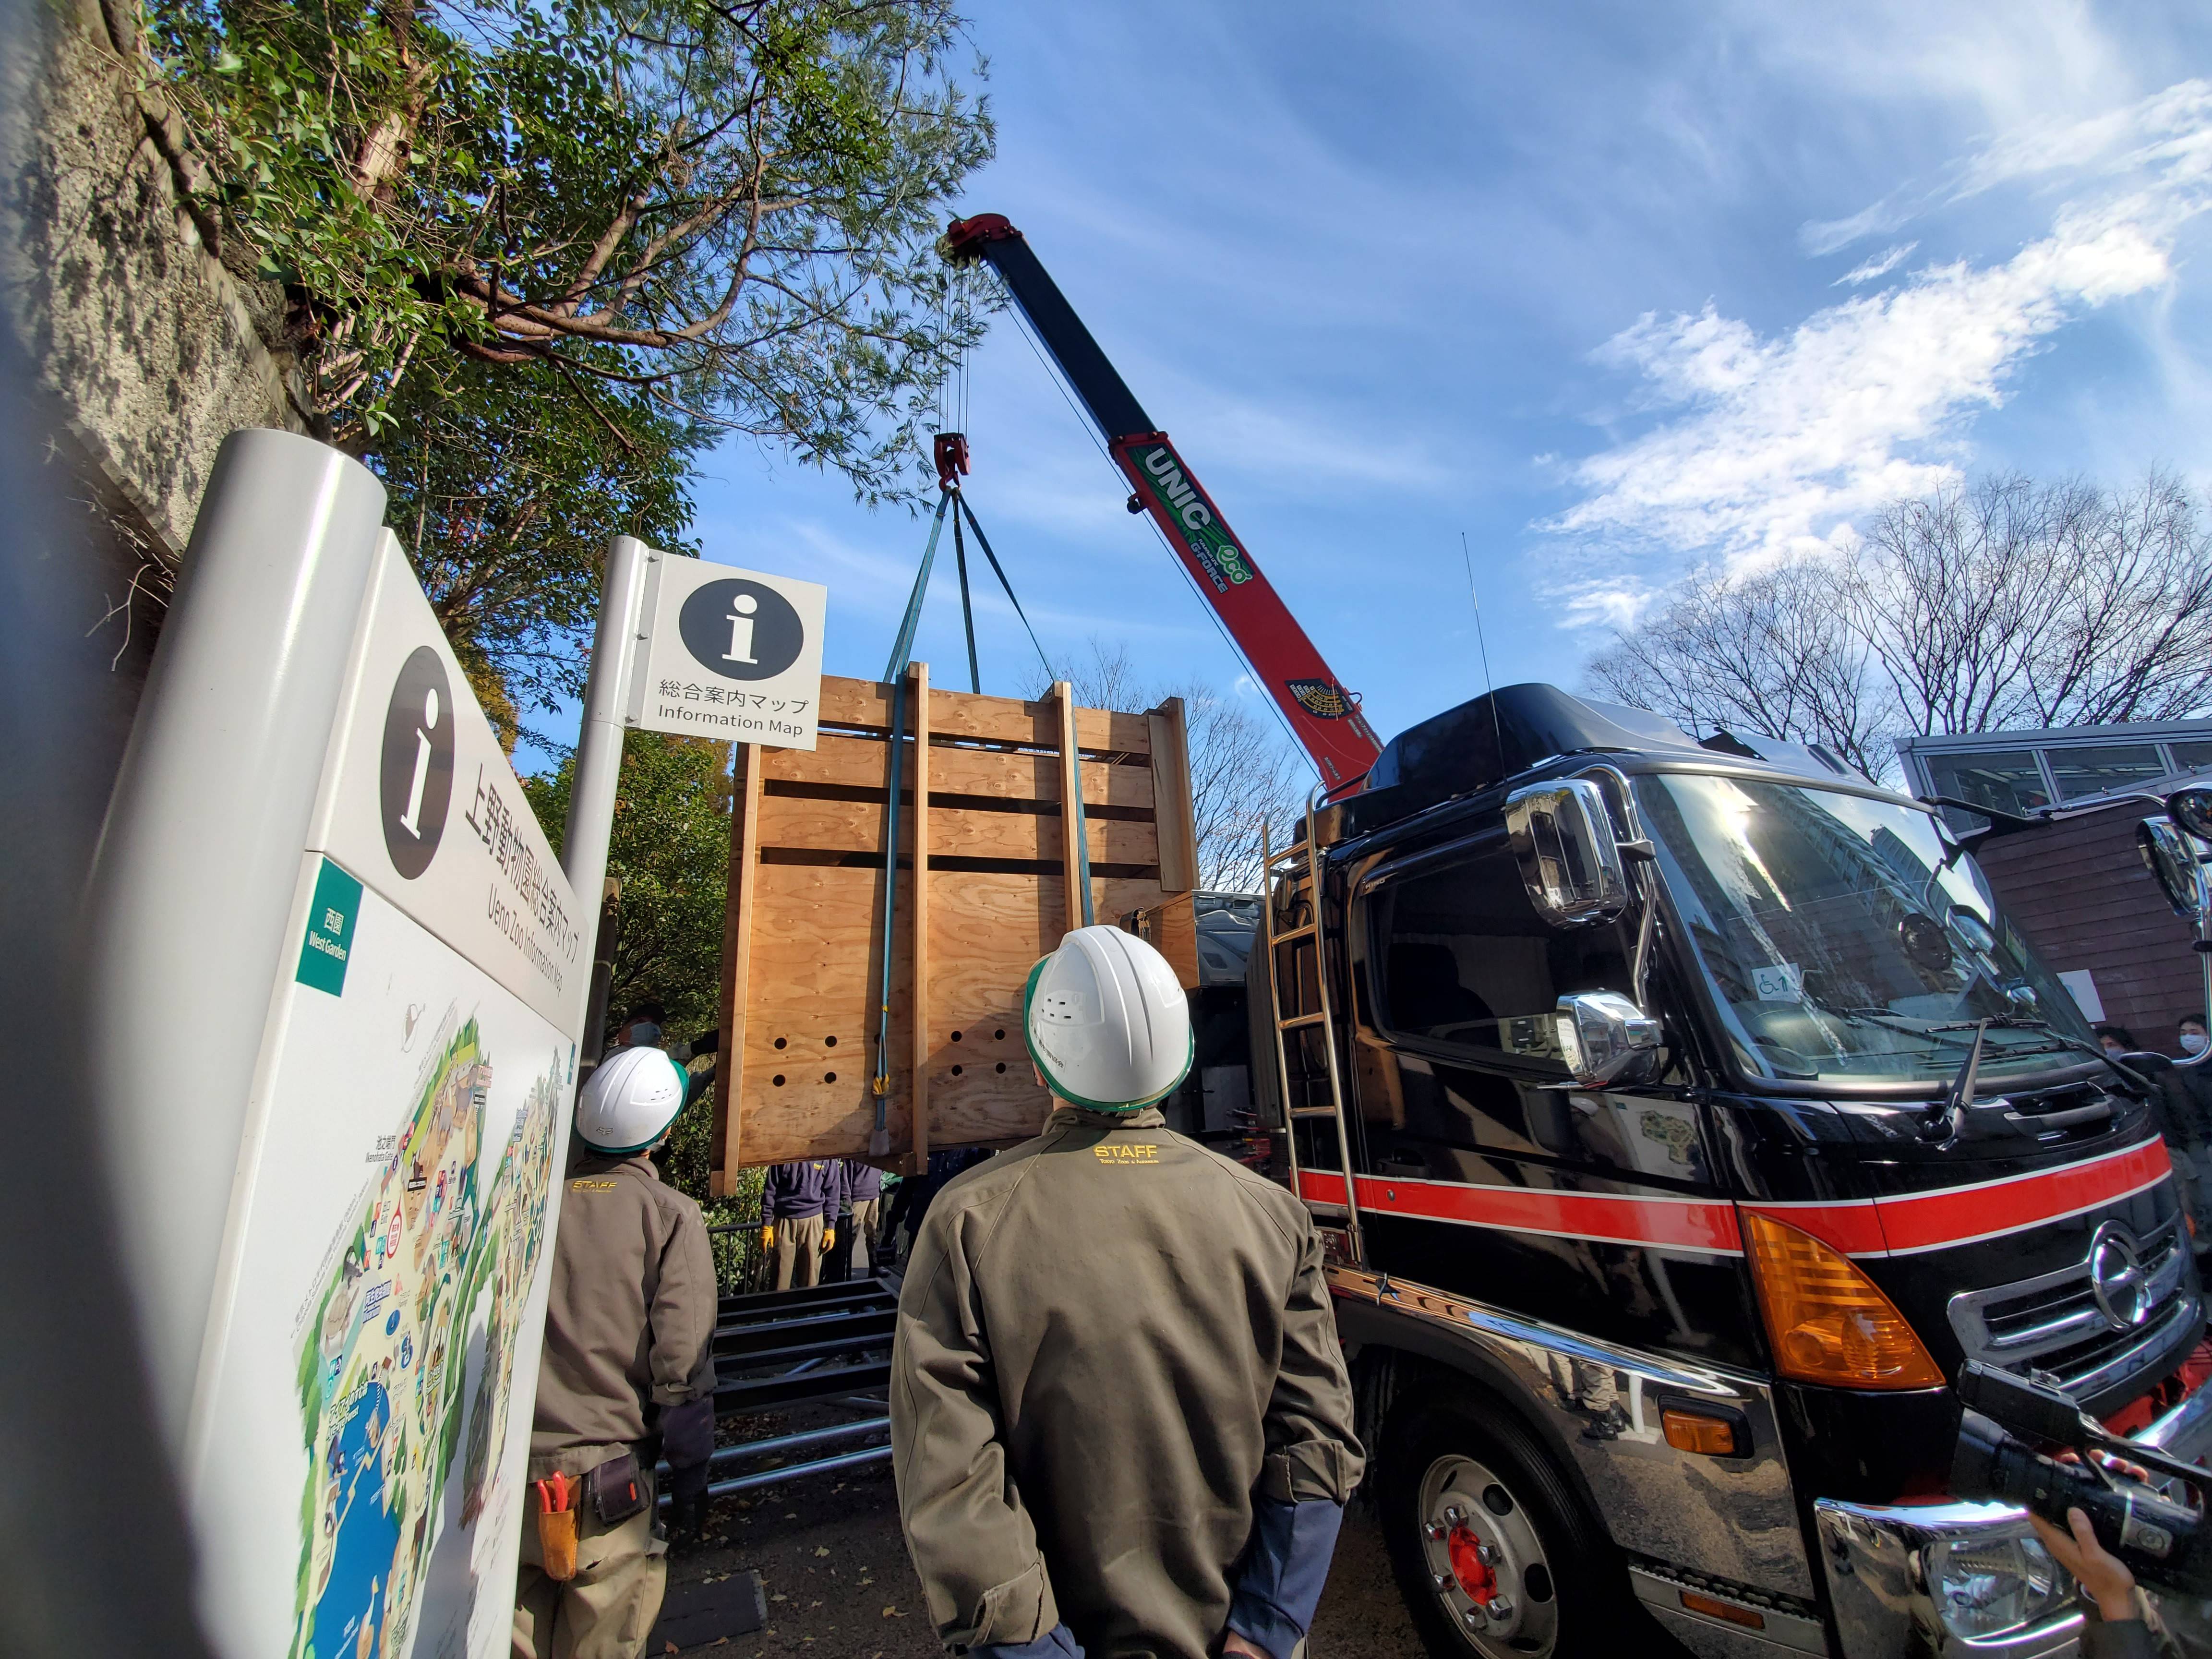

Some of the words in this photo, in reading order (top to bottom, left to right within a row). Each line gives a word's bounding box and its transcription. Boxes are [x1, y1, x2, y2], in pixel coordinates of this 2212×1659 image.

[1145, 447, 1211, 530] UNIC
[1217, 545, 1252, 584] eco
[659, 679, 809, 714] 総合案内マップ
[659, 705, 763, 730] Information
[769, 720, 803, 737] Map
[466, 762, 579, 965] 上野動物園総合案内マップ
[324, 907, 344, 936] 西園
[309, 930, 326, 951] West
[325, 939, 347, 961] Garden
[489, 883, 510, 935] Ueno
[510, 910, 524, 950] Zoo
[524, 926, 554, 983] Information
[553, 963, 563, 998] Map
[1094, 1145, 1157, 1158] STAFF
[573, 1180, 618, 1189] STAFF
